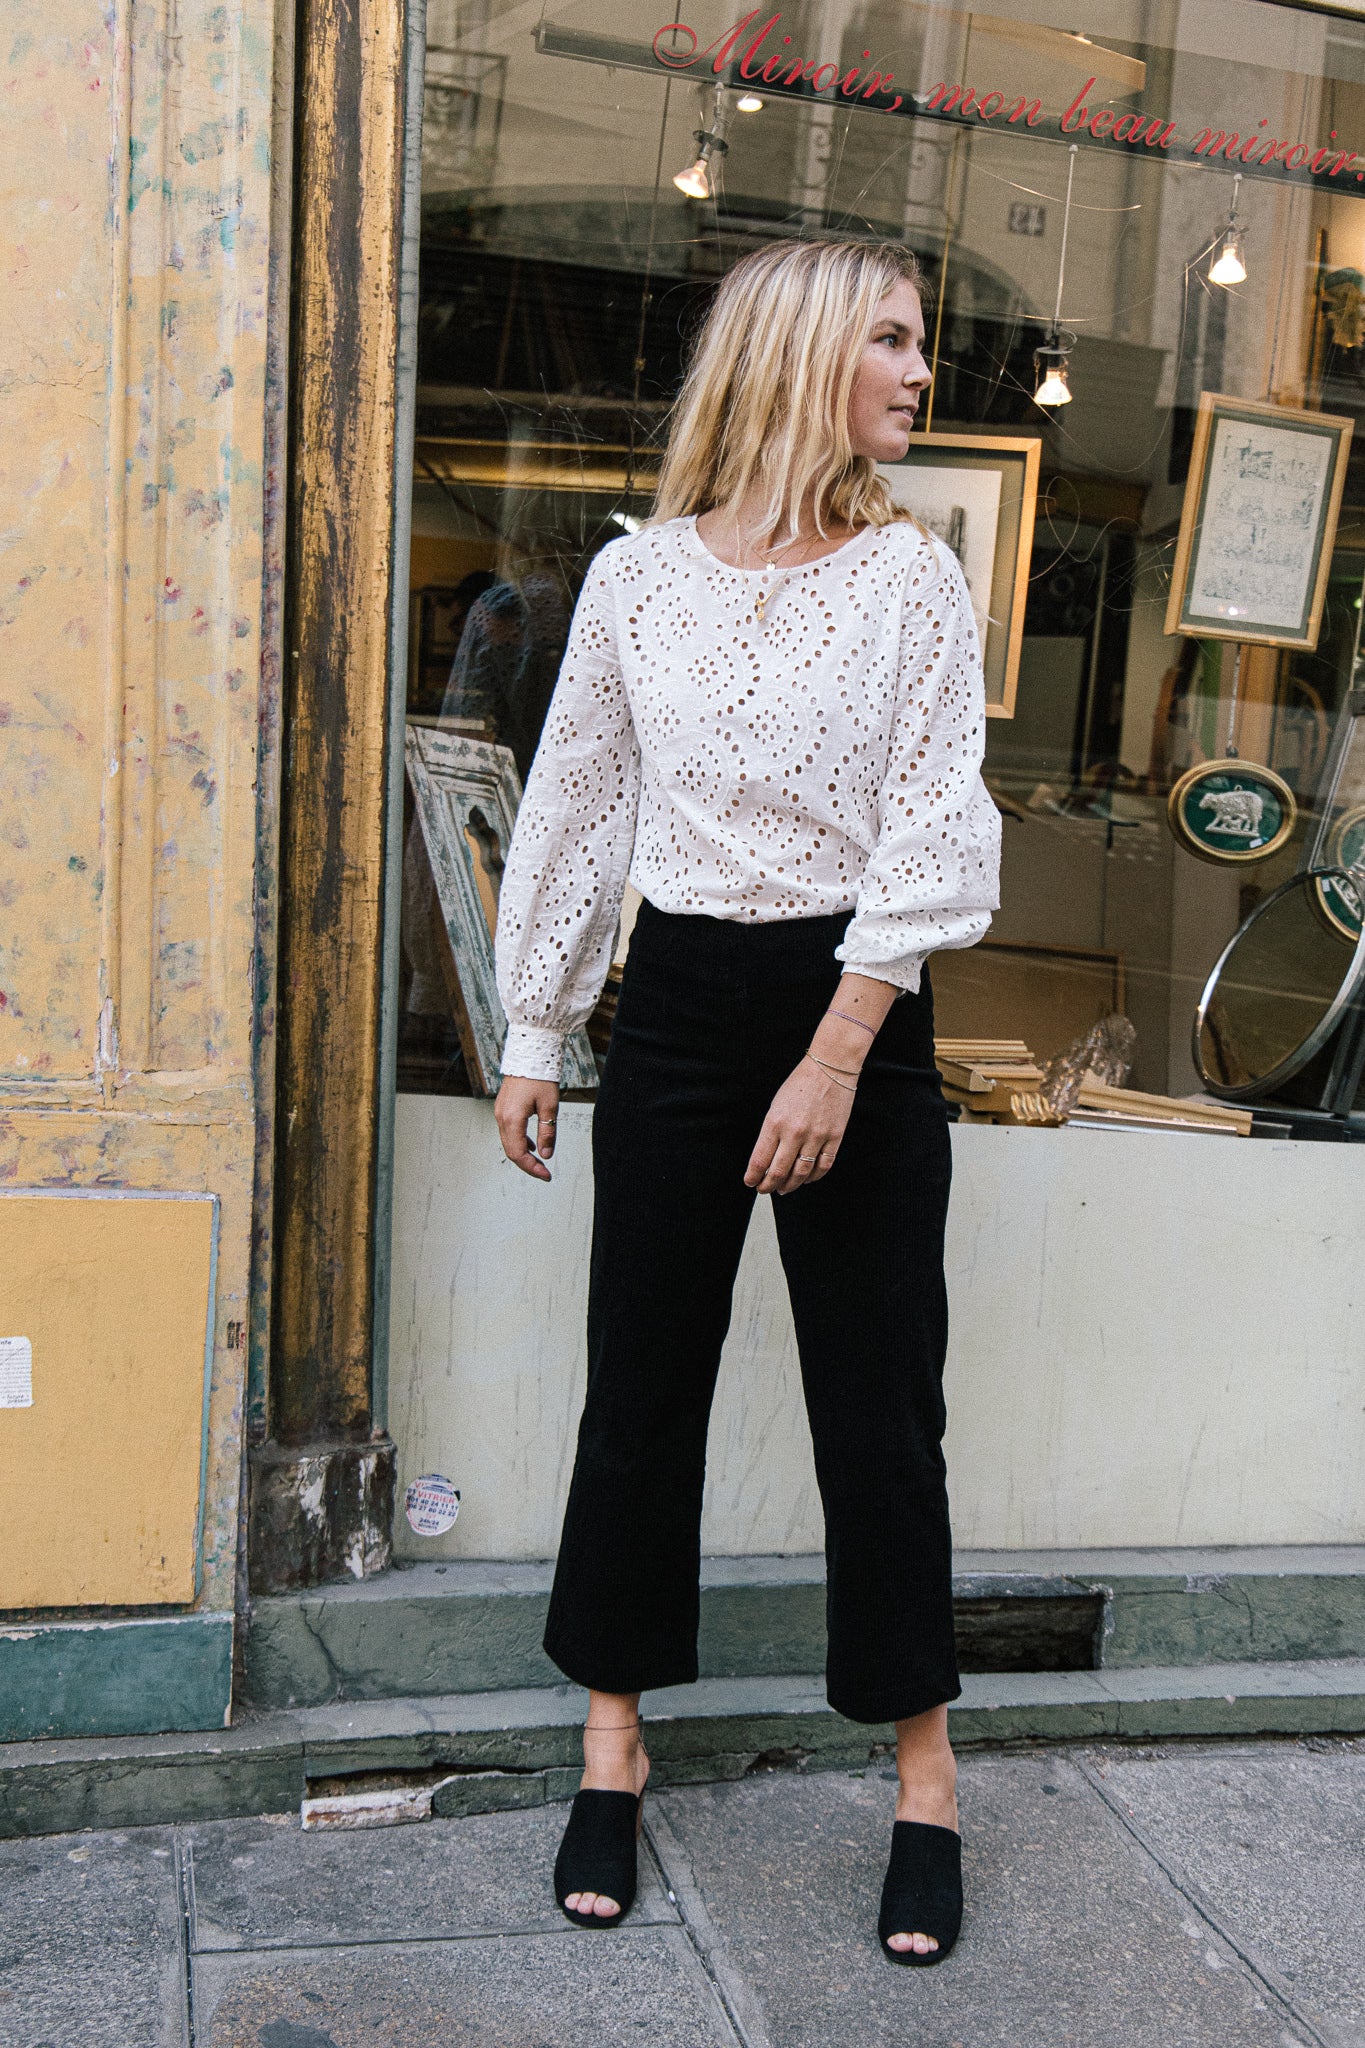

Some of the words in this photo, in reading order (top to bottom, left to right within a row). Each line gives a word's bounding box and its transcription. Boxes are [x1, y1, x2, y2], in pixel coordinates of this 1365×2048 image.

[653, 8, 903, 112] Miroir,
[925, 82, 1046, 127] mon
[1060, 77, 1178, 149] beau
[1190, 118, 1364, 182] miroir.
